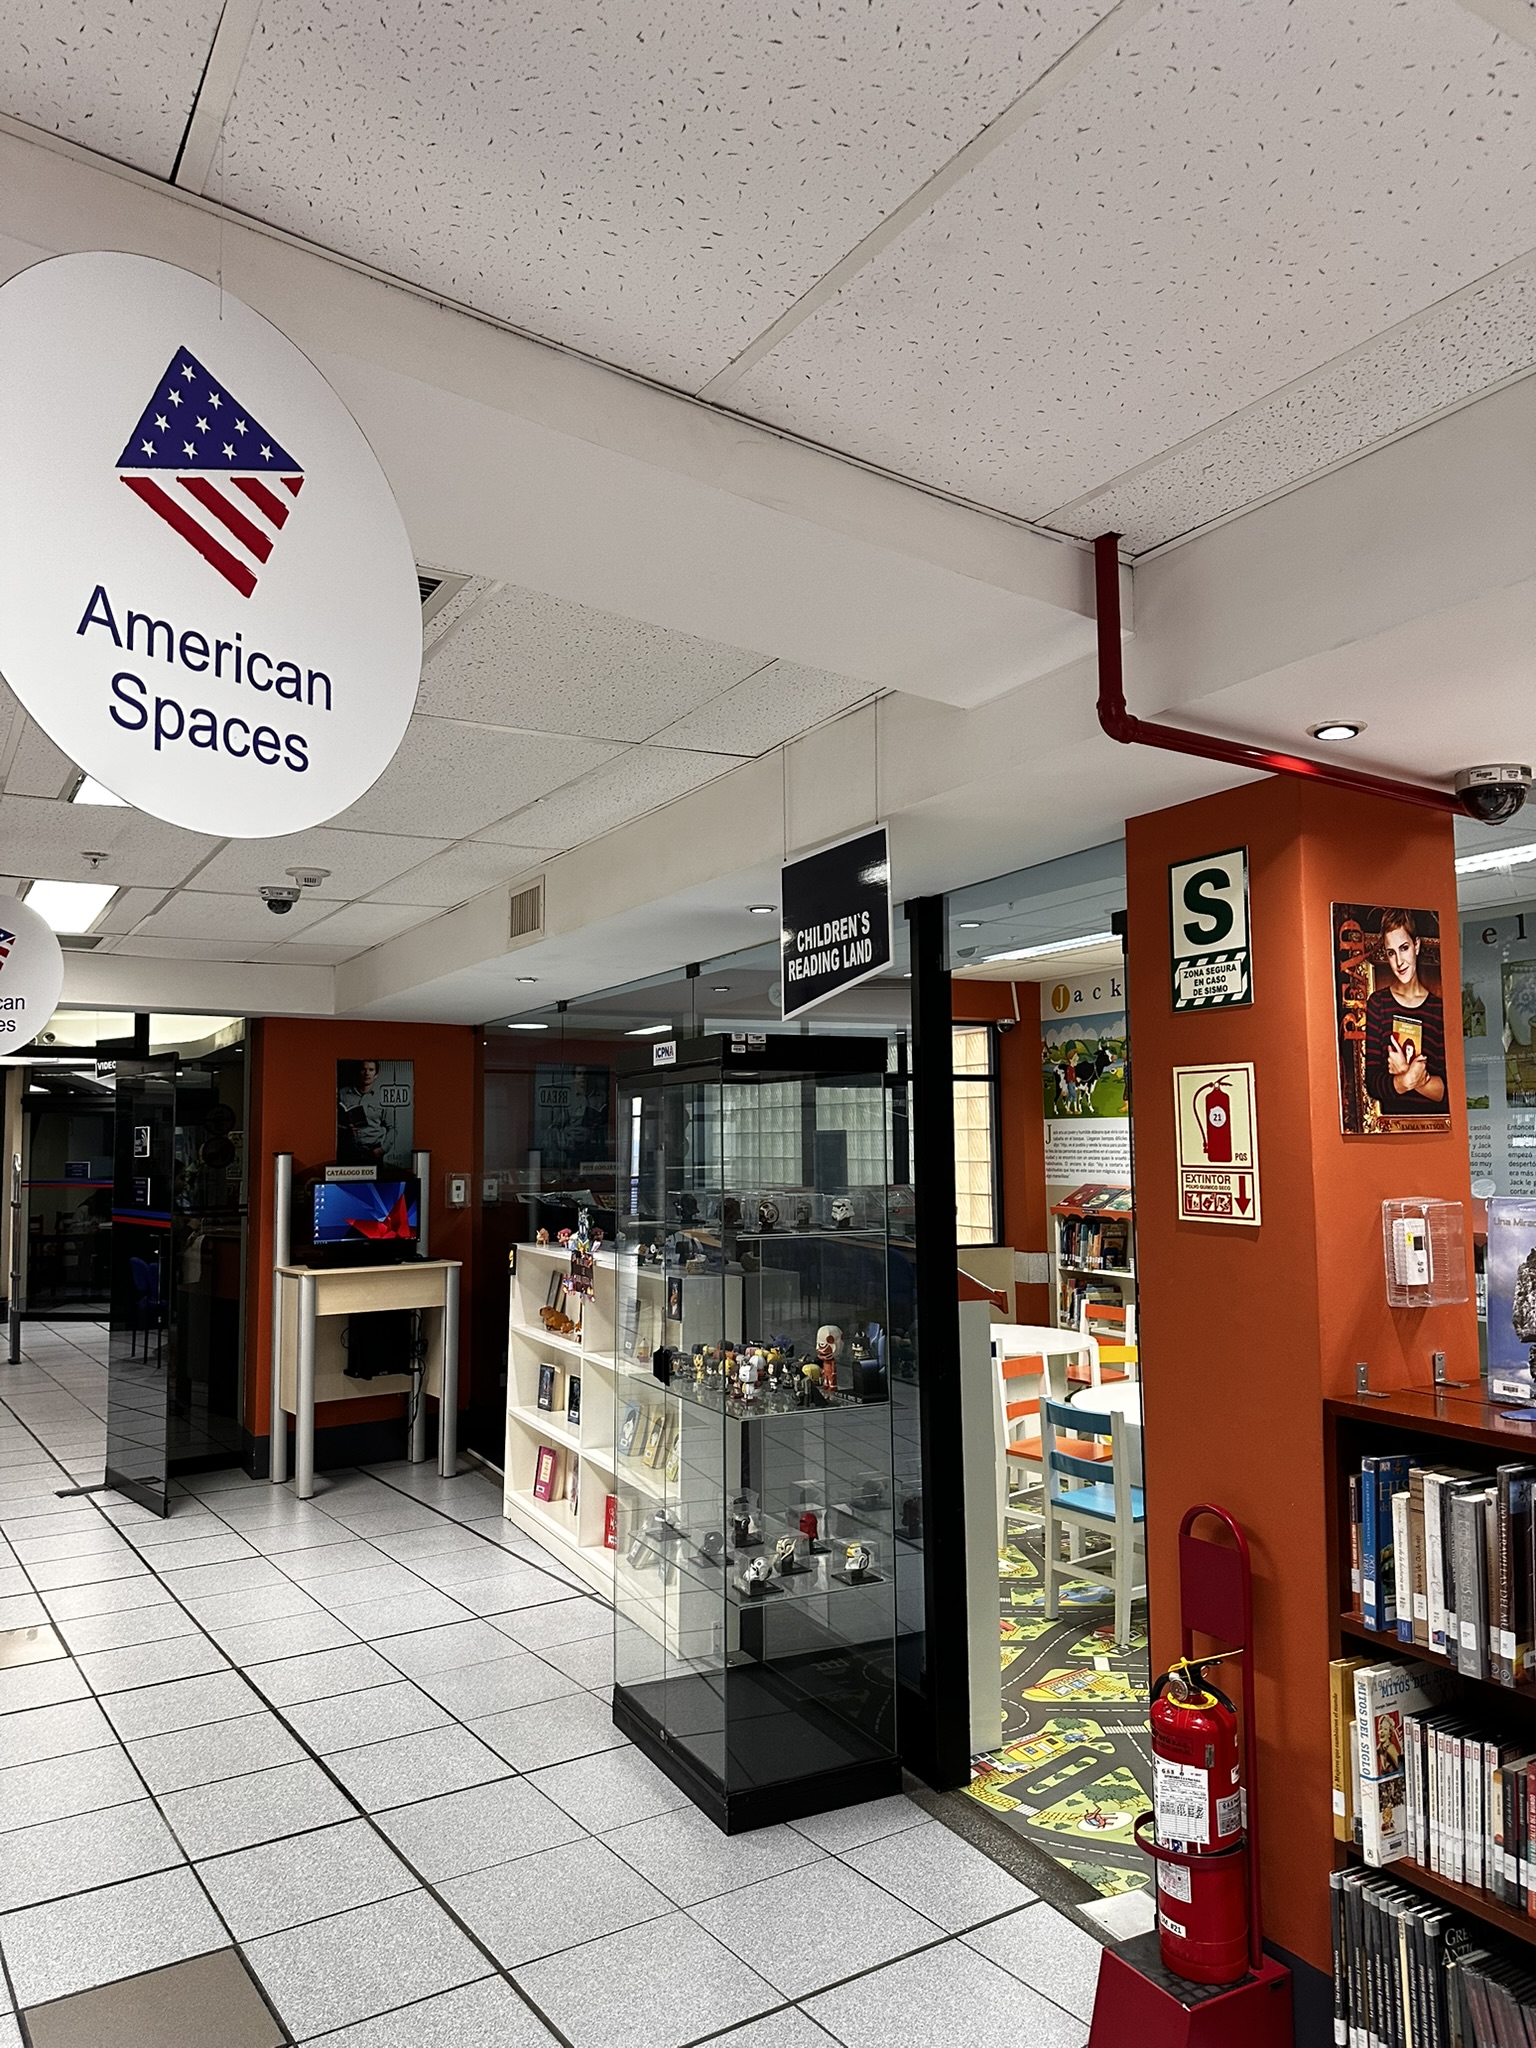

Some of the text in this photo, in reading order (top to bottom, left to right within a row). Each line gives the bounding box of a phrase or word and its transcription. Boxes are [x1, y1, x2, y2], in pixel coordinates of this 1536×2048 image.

[76, 585, 333, 711] American
[109, 671, 309, 773] Spaces
[1183, 868, 1234, 945] S
[788, 938, 872, 982] READING LAND
[1183, 963, 1237, 979] ZONA SEGURA
[1194, 975, 1226, 987] EN CASO
[1339, 919, 1366, 1041] READ
[1193, 985, 1228, 996] DE SISMO
[655, 1045, 674, 1059] ICPNA
[383, 1088, 408, 1103] READ
[1213, 1113, 1222, 1121] 21
[1401, 1121, 1445, 1131] EMMA WATSON
[1234, 1152, 1248, 1161] PQS
[326, 1167, 374, 1177] CATÁLOGO EOS
[1185, 1174, 1231, 1185] EXTINTOR
[1493, 1217, 1511, 1227] Una
[1381, 1679, 1410, 1698] MITOS
[1357, 1681, 1367, 1715] MITOS
[1360, 1717, 1369, 1742] DEL
[1361, 1744, 1371, 1776] SIGLO
